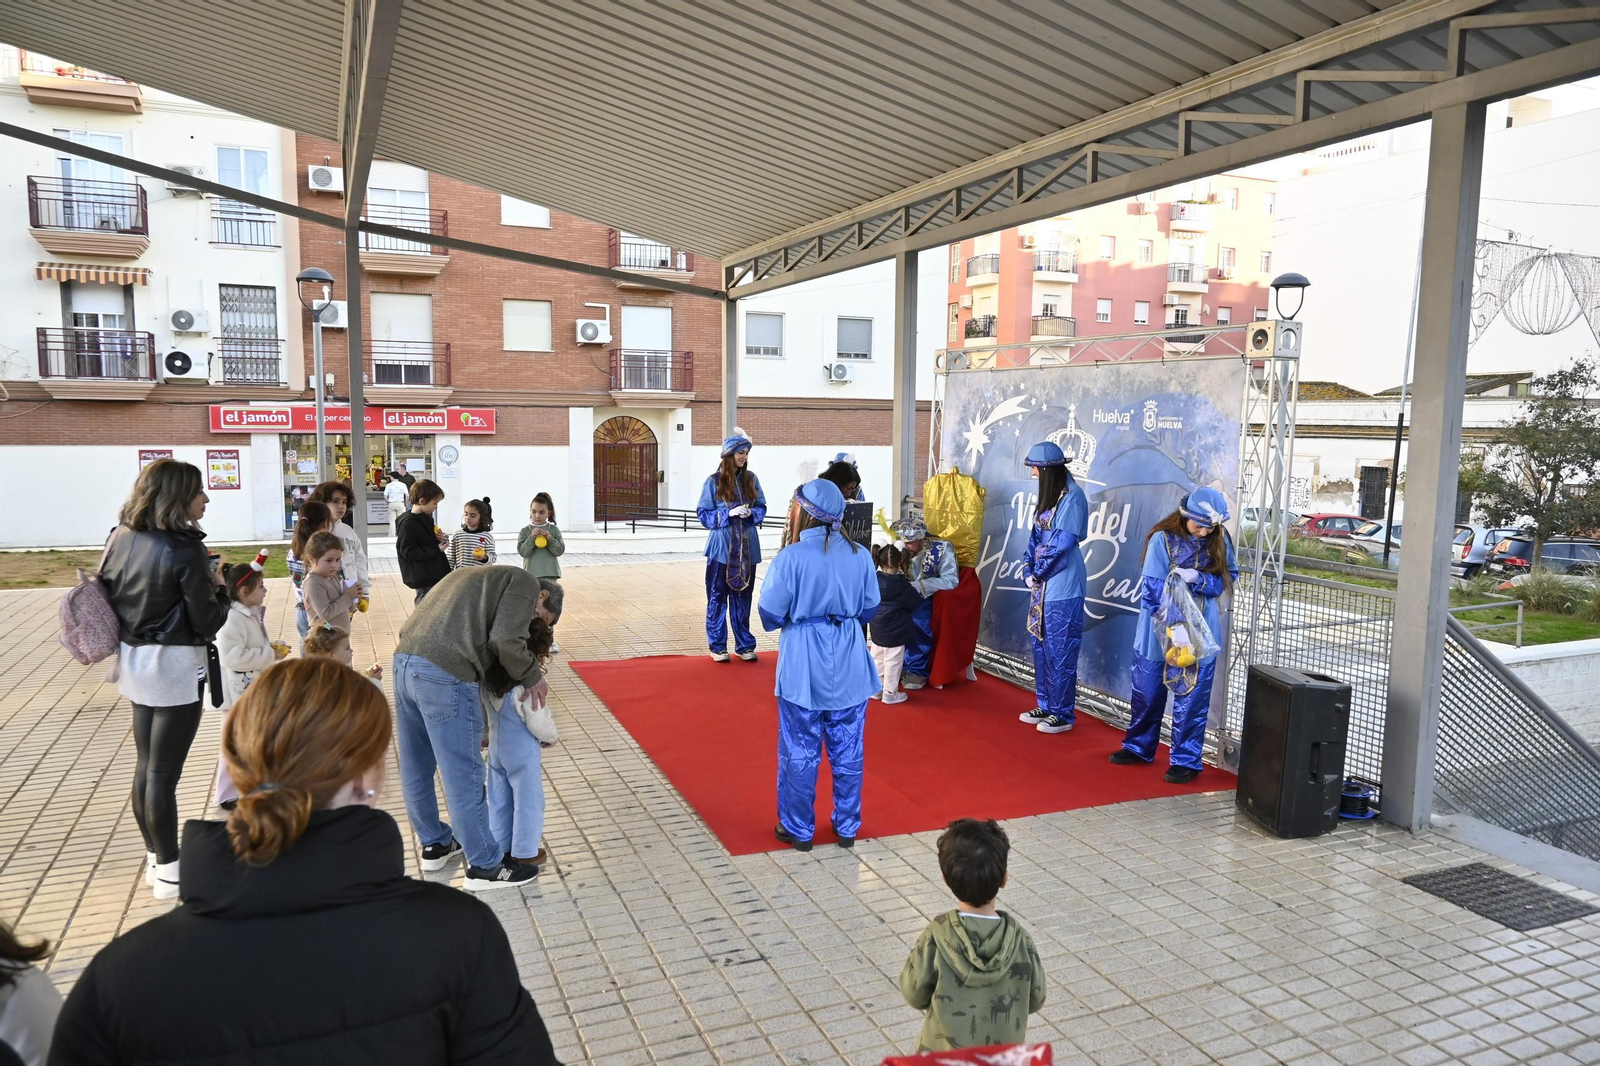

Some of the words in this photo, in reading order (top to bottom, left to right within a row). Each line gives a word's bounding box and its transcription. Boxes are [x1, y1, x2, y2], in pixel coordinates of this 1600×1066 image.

[226, 411, 239, 422] el
[241, 410, 287, 425] jamón
[305, 414, 313, 422] El
[314, 415, 337, 423] sper
[388, 413, 400, 423] el
[402, 411, 443, 425] jamón
[1093, 409, 1130, 423] Huelva
[1157, 421, 1182, 429] HUELVA
[1087, 502, 1131, 543] del
[975, 519, 1026, 609] Hera
